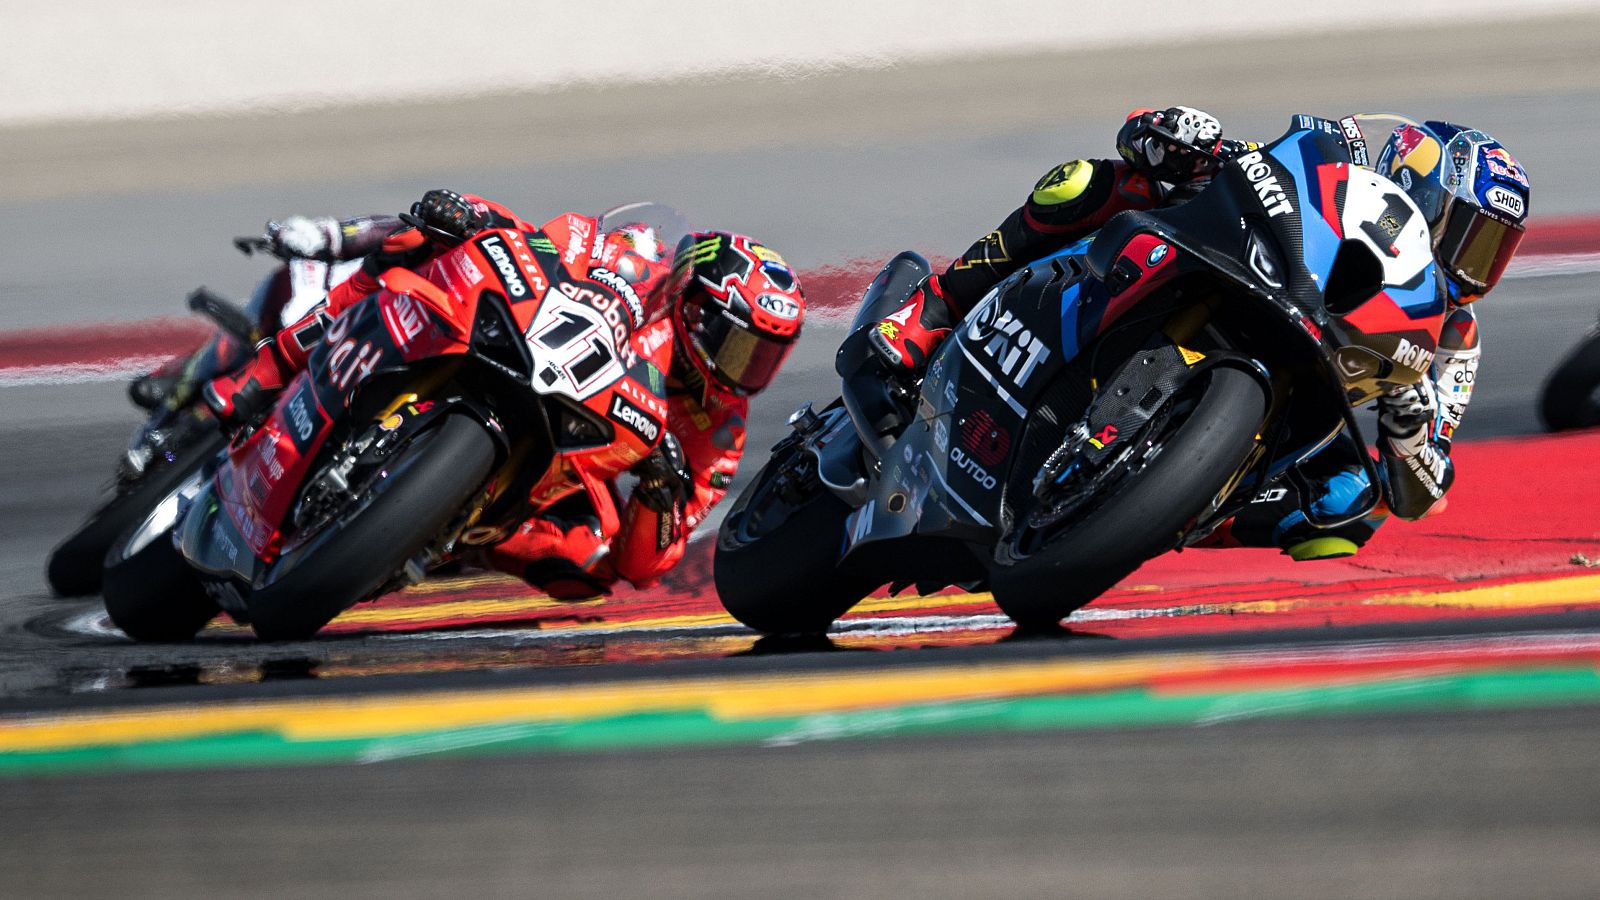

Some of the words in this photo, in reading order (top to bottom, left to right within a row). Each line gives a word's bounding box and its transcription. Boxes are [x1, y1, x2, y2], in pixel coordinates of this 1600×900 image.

[1236, 150, 1294, 218] ROKiT
[1494, 189, 1522, 213] SHOEI
[481, 236, 526, 297] Lenovo
[590, 267, 645, 329] CARRERA
[528, 306, 619, 392] 11
[612, 397, 658, 441] Lenovo
[950, 447, 997, 490] OUTDO
